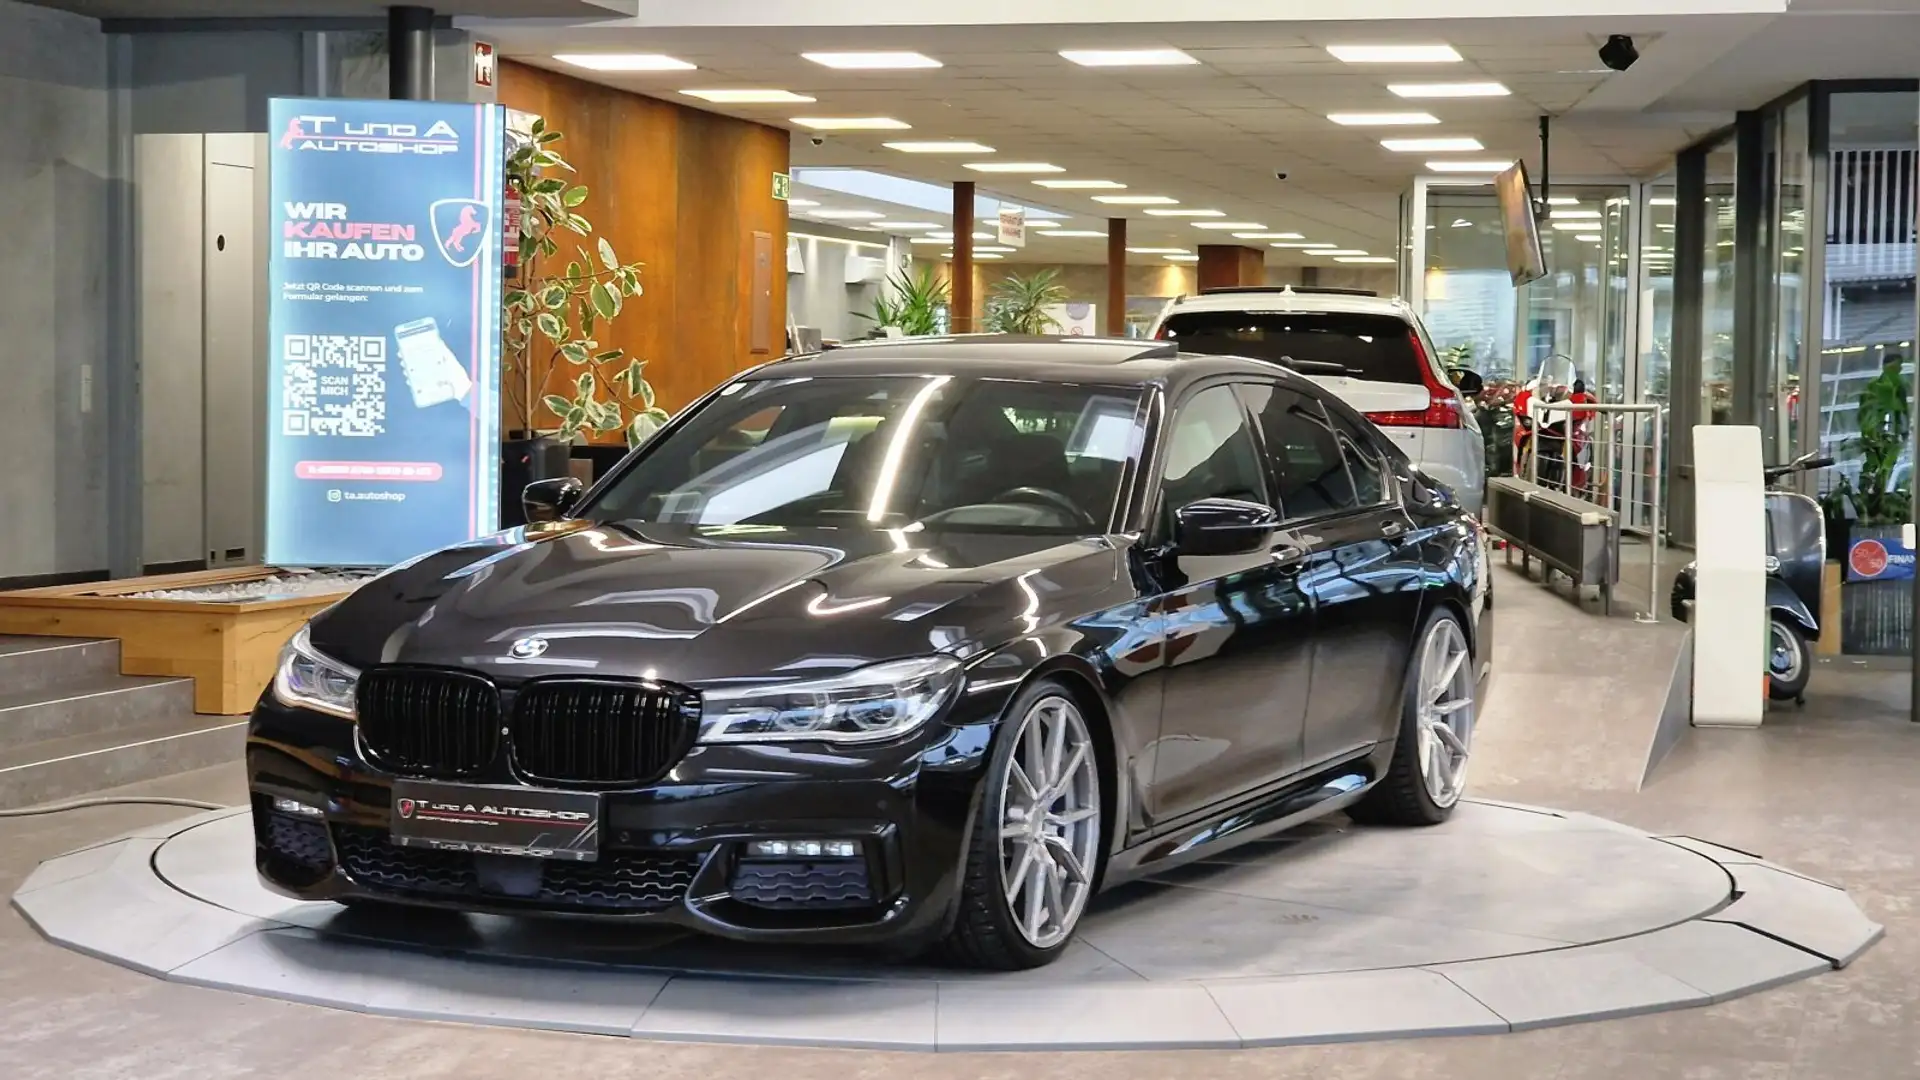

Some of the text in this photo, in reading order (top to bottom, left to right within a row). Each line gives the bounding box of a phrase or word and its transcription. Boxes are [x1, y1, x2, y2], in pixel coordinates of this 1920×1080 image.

[300, 115, 336, 133] T
[423, 120, 459, 138] A
[299, 139, 459, 154] AUTOSHOP
[284, 202, 347, 220] WIR
[284, 221, 415, 241] KAUFEN
[284, 241, 425, 261] IHR AUTO
[283, 282, 424, 293] Jetzt QR Code scannen und zum
[282, 292, 323, 300] Formular
[321, 375, 349, 385] SCAN
[321, 386, 349, 396] MICH
[344, 491, 406, 502] ta.autoshop
[416, 800, 429, 808] T
[463, 804, 477, 813] A
[480, 805, 590, 820] AUTOSHOP
[473, 844, 554, 857] AUTOSHOP
